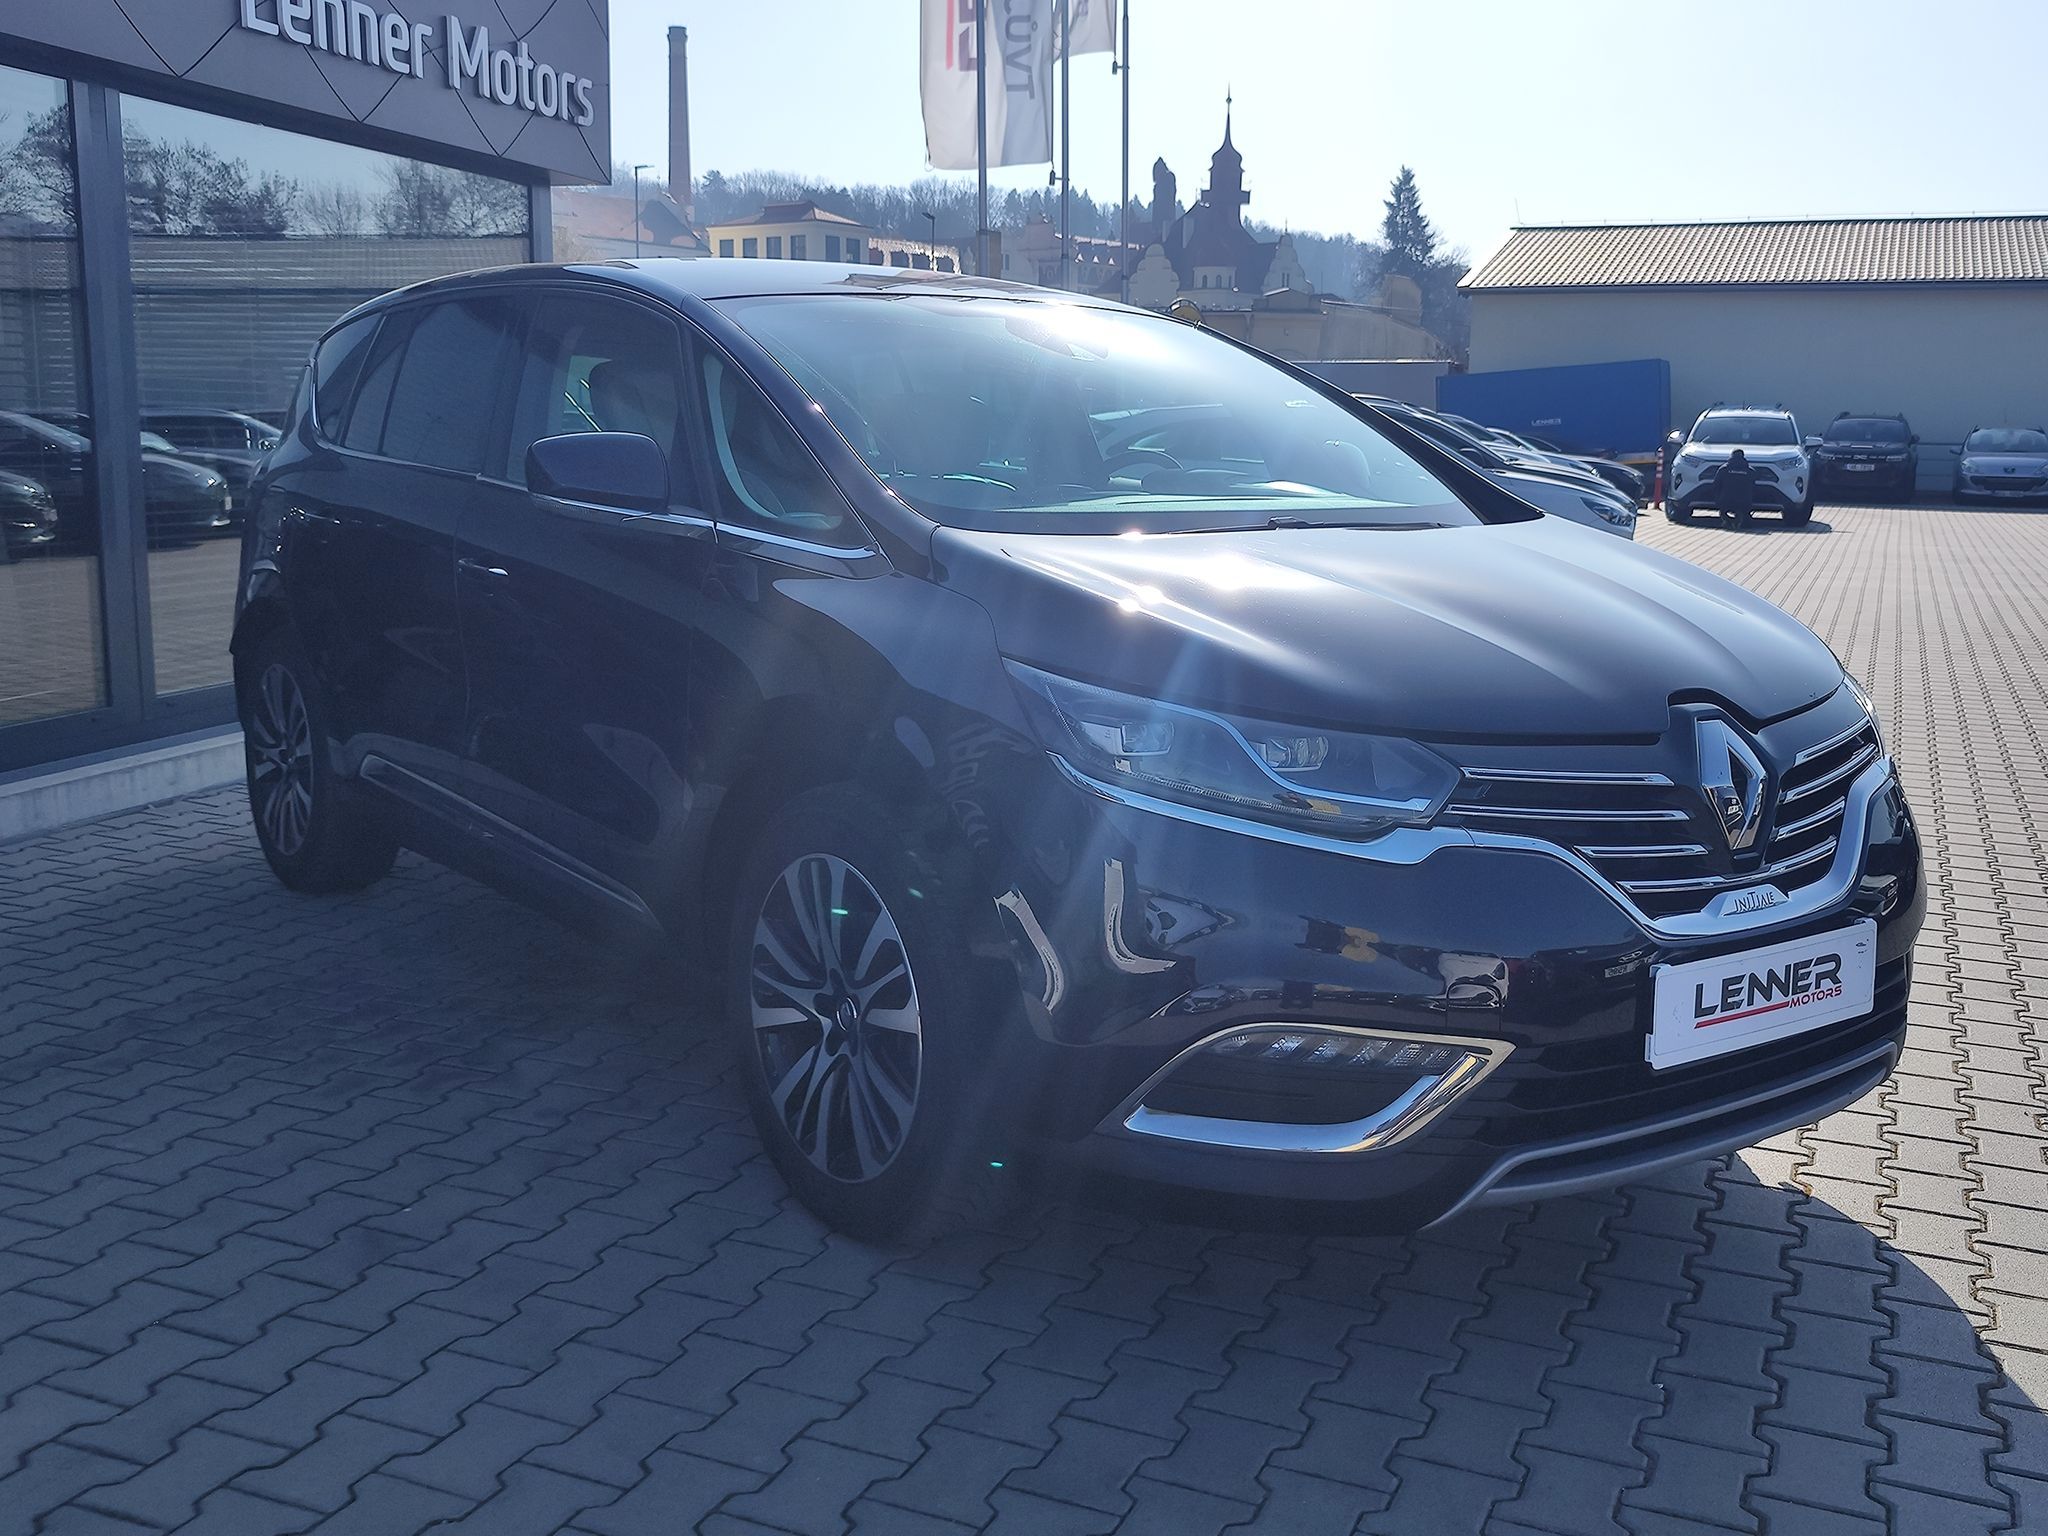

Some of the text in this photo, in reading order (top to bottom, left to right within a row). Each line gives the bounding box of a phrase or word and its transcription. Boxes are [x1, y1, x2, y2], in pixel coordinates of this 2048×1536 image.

[445, 15, 594, 127] Motors
[1734, 891, 1775, 912] INITIALE
[1694, 953, 1843, 1019] LENNER
[1789, 985, 1843, 1009] MOTORS
